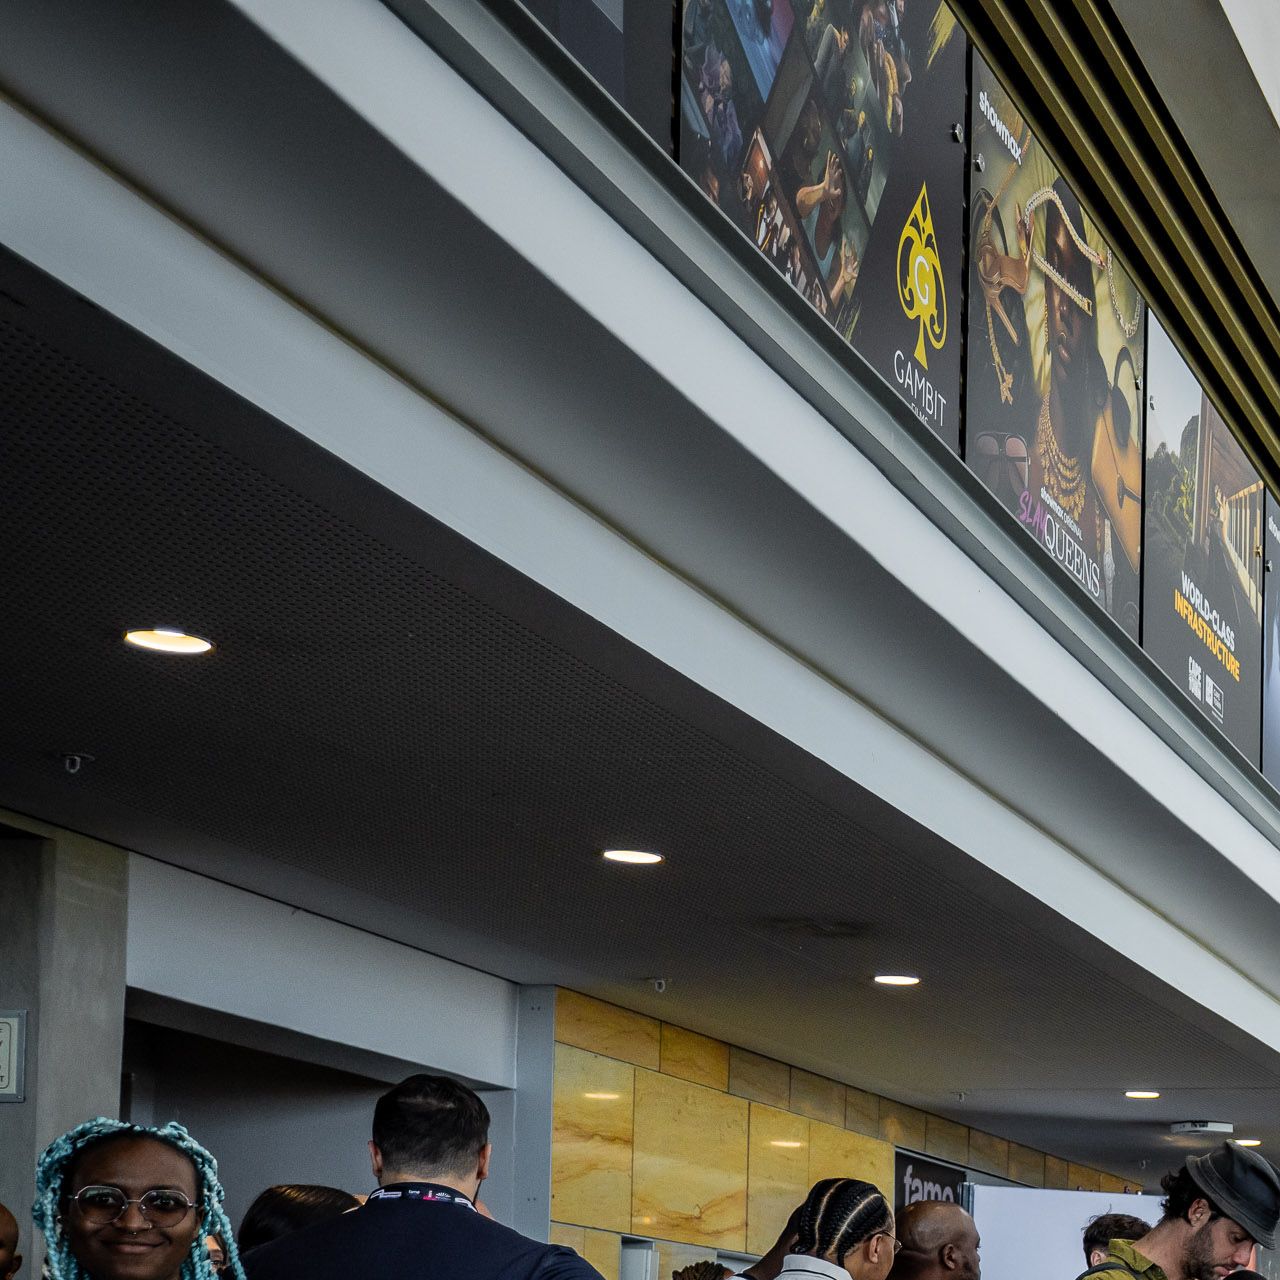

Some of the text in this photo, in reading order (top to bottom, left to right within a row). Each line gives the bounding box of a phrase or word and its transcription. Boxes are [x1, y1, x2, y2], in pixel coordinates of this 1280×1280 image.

[979, 91, 1021, 165] showmax
[894, 350, 946, 427] GAMBIT
[1045, 514, 1100, 597] QUEENS
[1174, 588, 1240, 683] INFRASTRUCTURE
[1181, 570, 1235, 652] WORLD-CLASS
